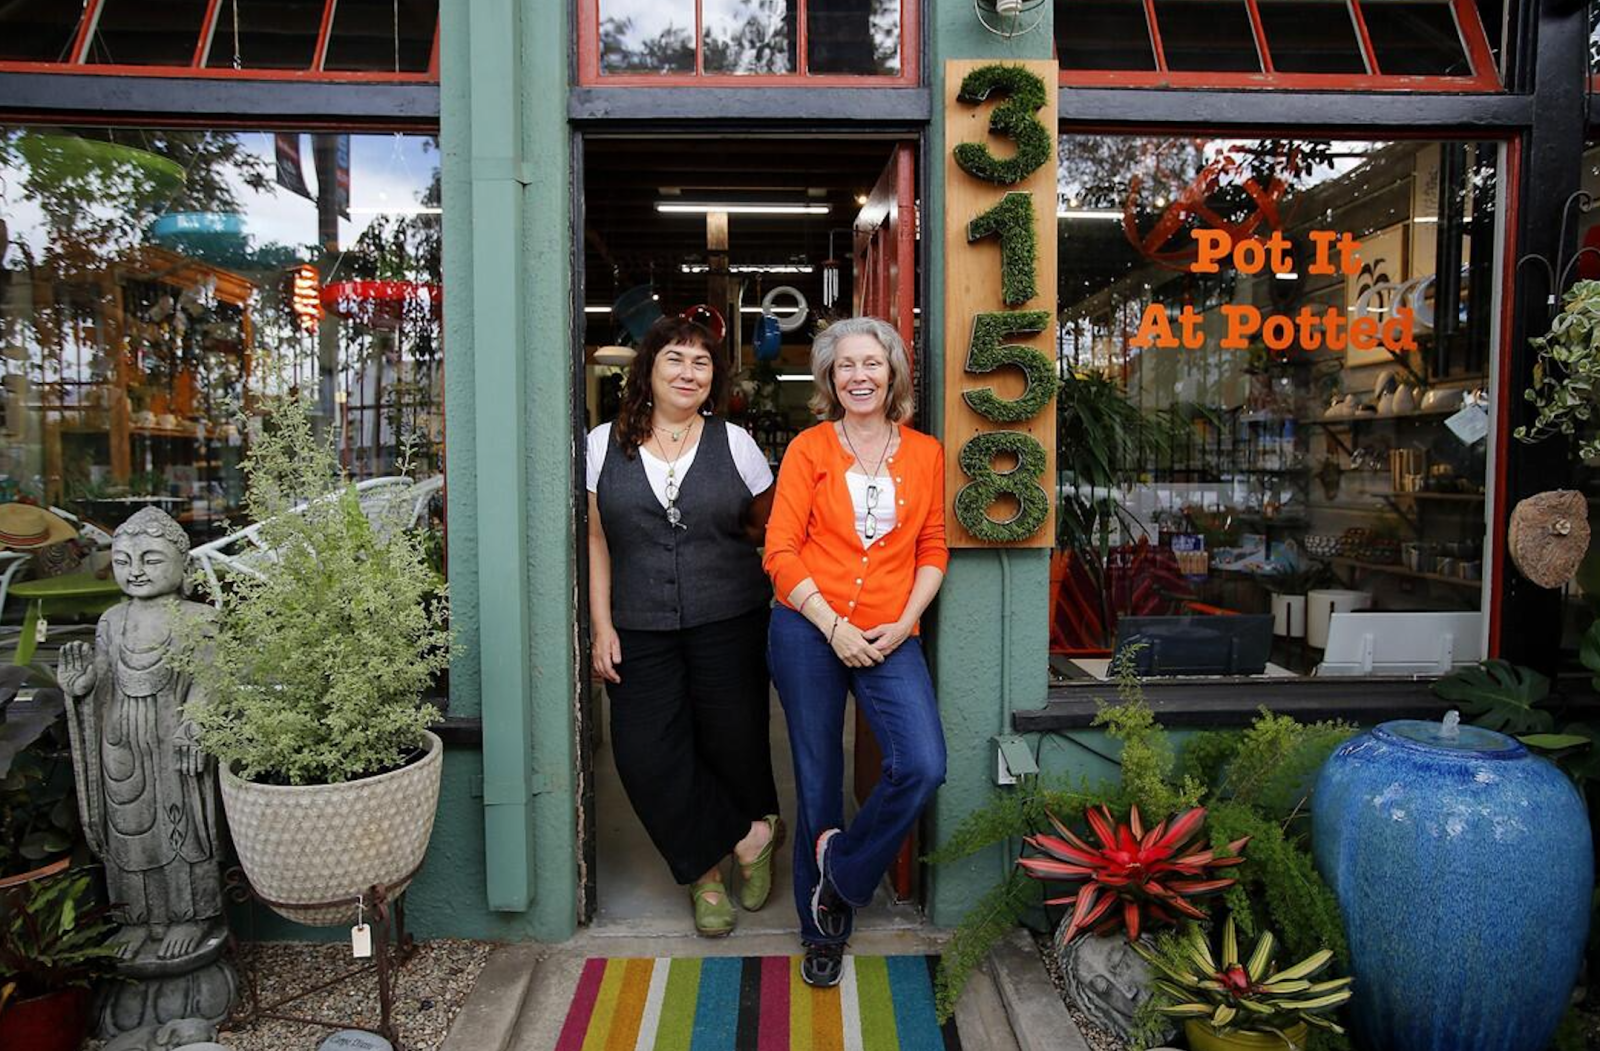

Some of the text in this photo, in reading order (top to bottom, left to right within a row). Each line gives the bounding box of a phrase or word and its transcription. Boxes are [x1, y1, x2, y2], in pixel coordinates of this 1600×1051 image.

[1190, 228, 1363, 275] Pot It
[953, 64, 1058, 543] 3158
[1129, 303, 1418, 350] At Potted
